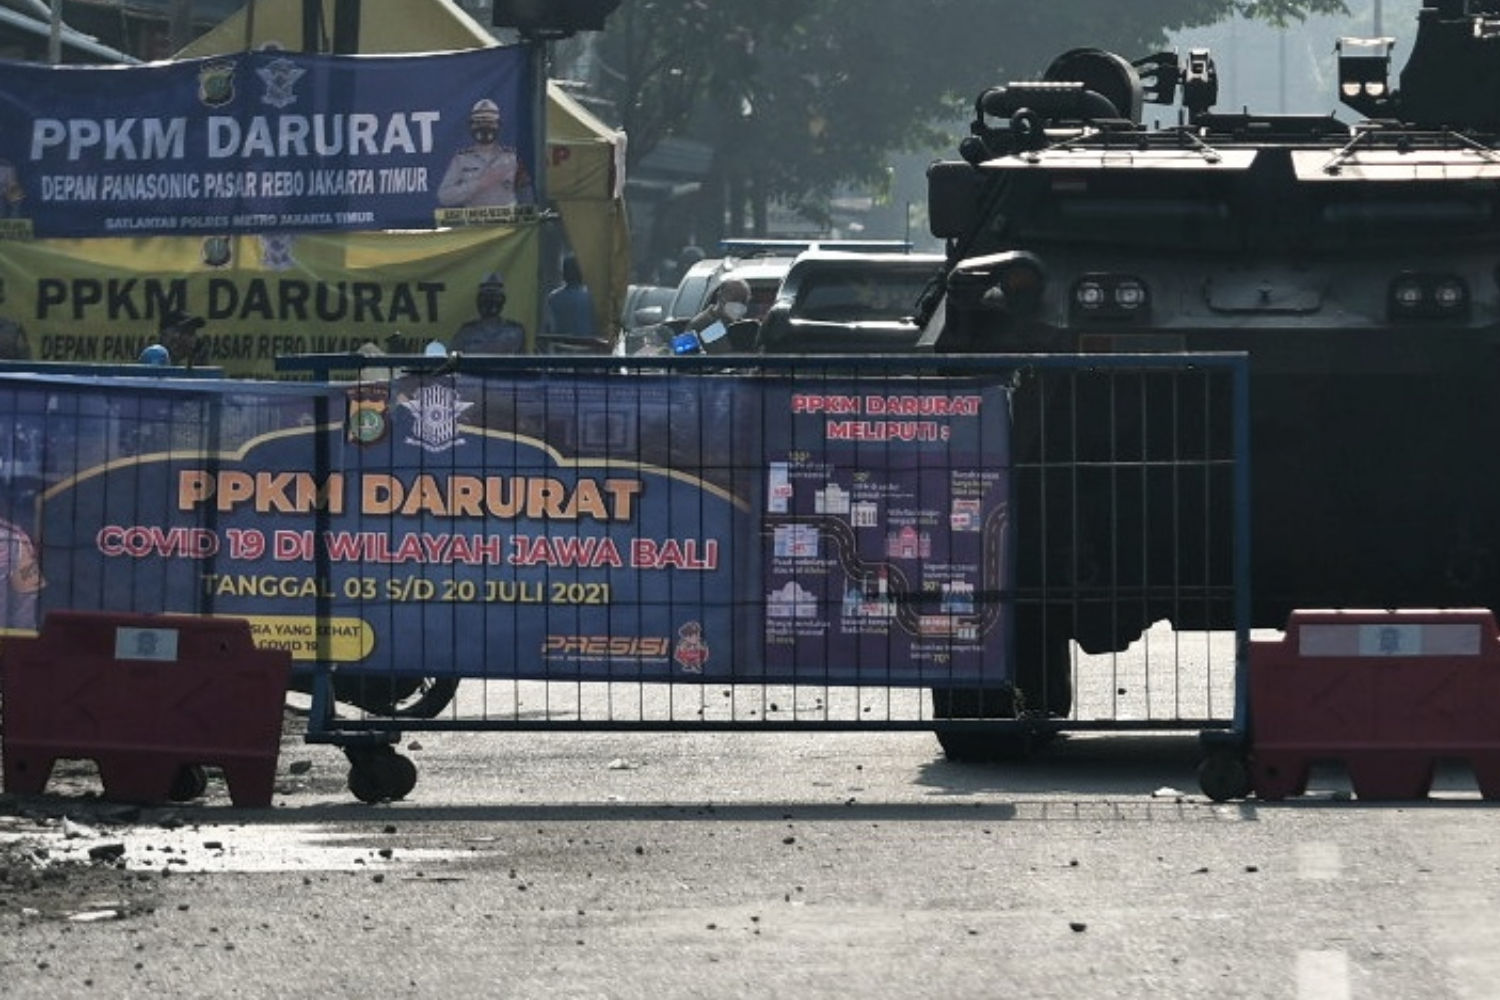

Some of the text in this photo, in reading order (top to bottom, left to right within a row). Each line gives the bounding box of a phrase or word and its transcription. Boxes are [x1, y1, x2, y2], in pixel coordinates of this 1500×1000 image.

[30, 111, 441, 161] PPKM DARURAT
[41, 167, 429, 201] DEPAN PANASONIC PASAR REBO JAKARTA TIMUR
[233, 213, 277, 227] METRO
[280, 212, 334, 226] JAKARTA
[336, 211, 375, 224] TIMUR
[36, 278, 447, 323] PPKM DARURAT
[41, 335, 99, 361] DEPAN
[792, 395, 982, 416] PPKM DARURAT
[826, 421, 937, 441] MELIPUTI
[178, 469, 642, 521] PPKM DARURAT
[96, 525, 719, 570] COVID 19 DI WILAYAH JAWA BALI
[200, 574, 610, 605] TANGGAL 03 S/D 20 JULI 2021
[274, 624, 312, 636] YANG
[541, 634, 670, 656] PRESISI
